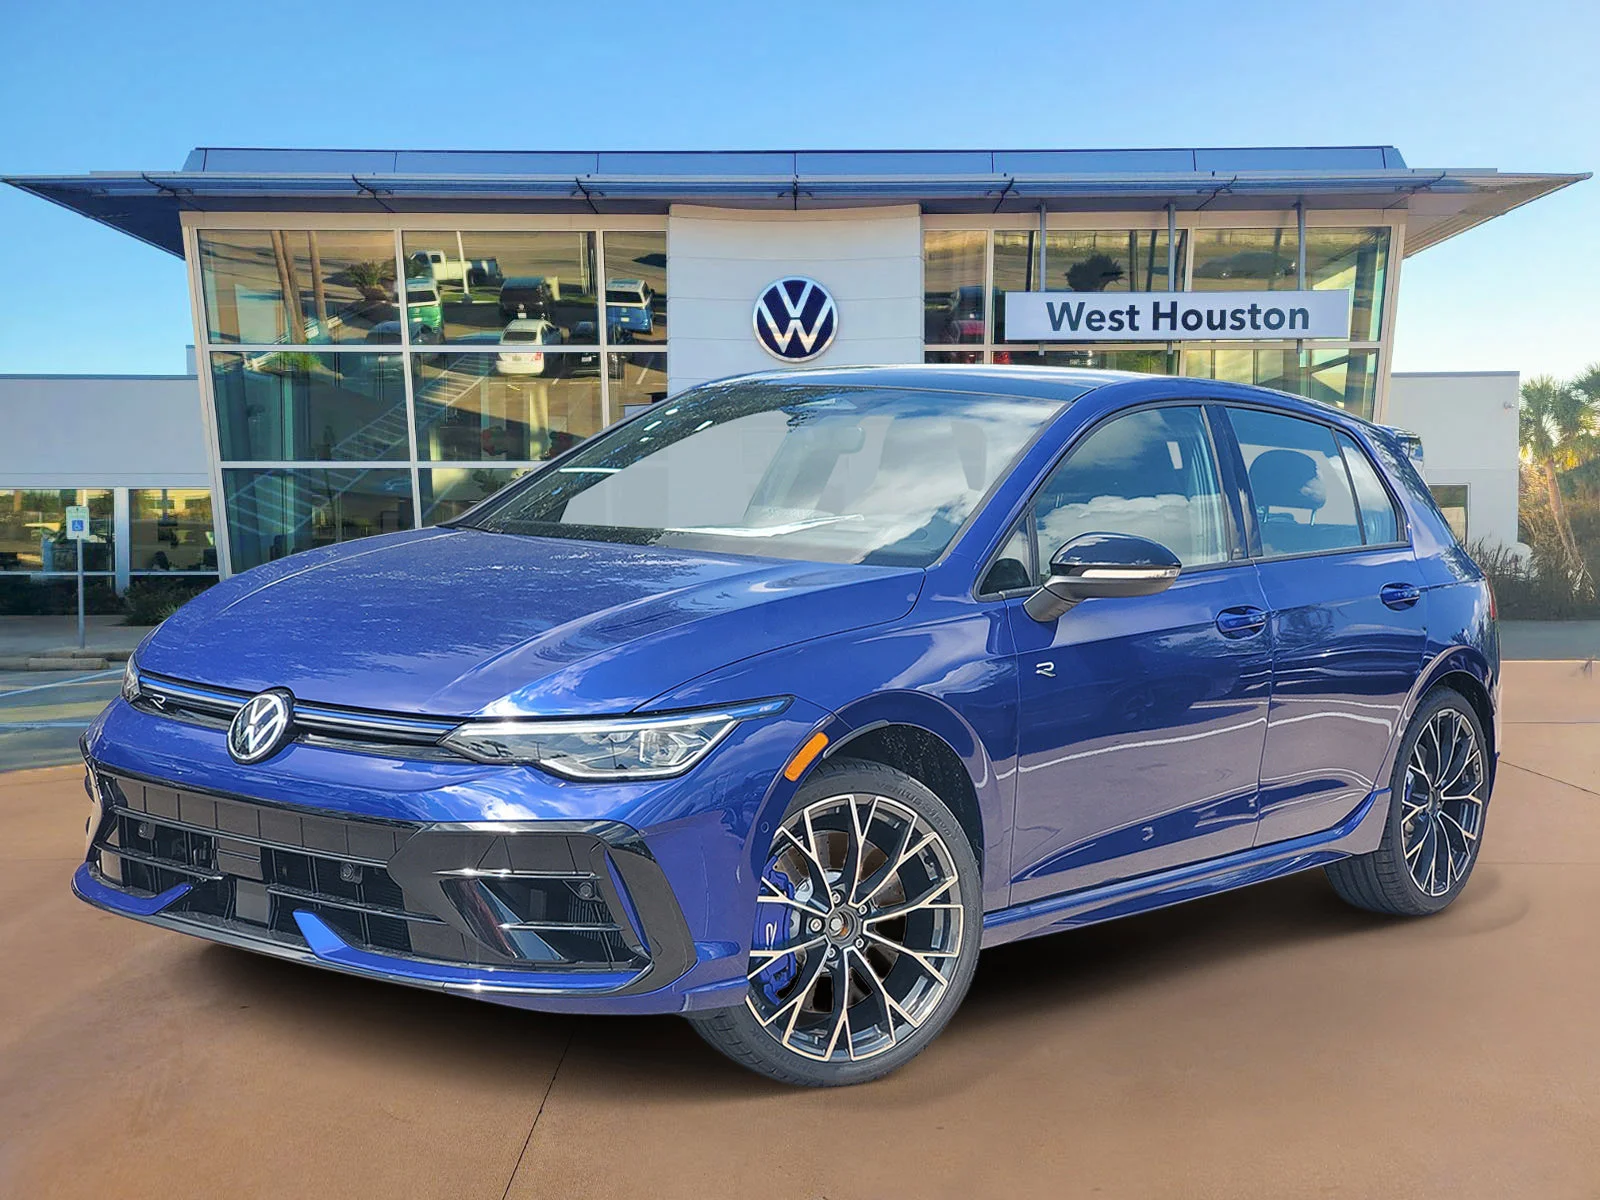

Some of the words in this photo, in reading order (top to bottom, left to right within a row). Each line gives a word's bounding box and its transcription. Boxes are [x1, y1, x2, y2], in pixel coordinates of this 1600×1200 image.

[755, 277, 836, 359] VW
[1046, 301, 1140, 332] West
[1152, 301, 1310, 331] Houston
[1036, 661, 1056, 677] R
[231, 692, 286, 758] VW
